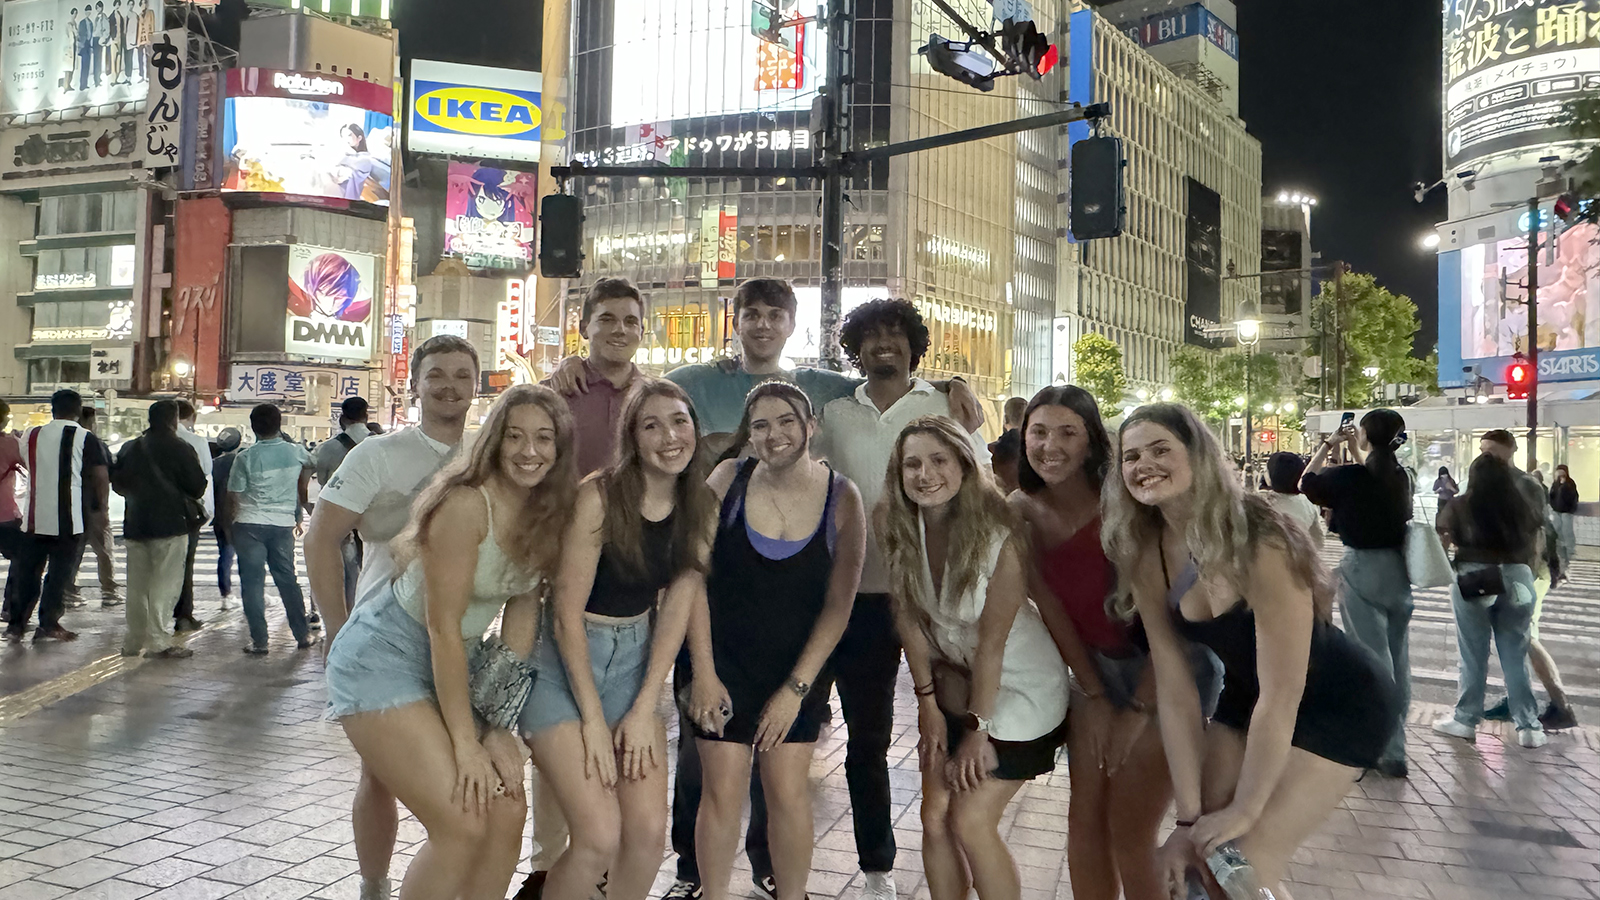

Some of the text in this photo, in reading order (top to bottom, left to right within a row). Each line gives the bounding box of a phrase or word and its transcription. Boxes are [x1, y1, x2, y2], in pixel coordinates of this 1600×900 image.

[273, 73, 344, 95] Rakuten
[147, 33, 182, 163] もんじゃ
[428, 97, 534, 125] IKEA
[912, 297, 994, 331] STARBUCKS
[293, 320, 365, 347] DMM
[237, 371, 361, 396] 大盛堂店
